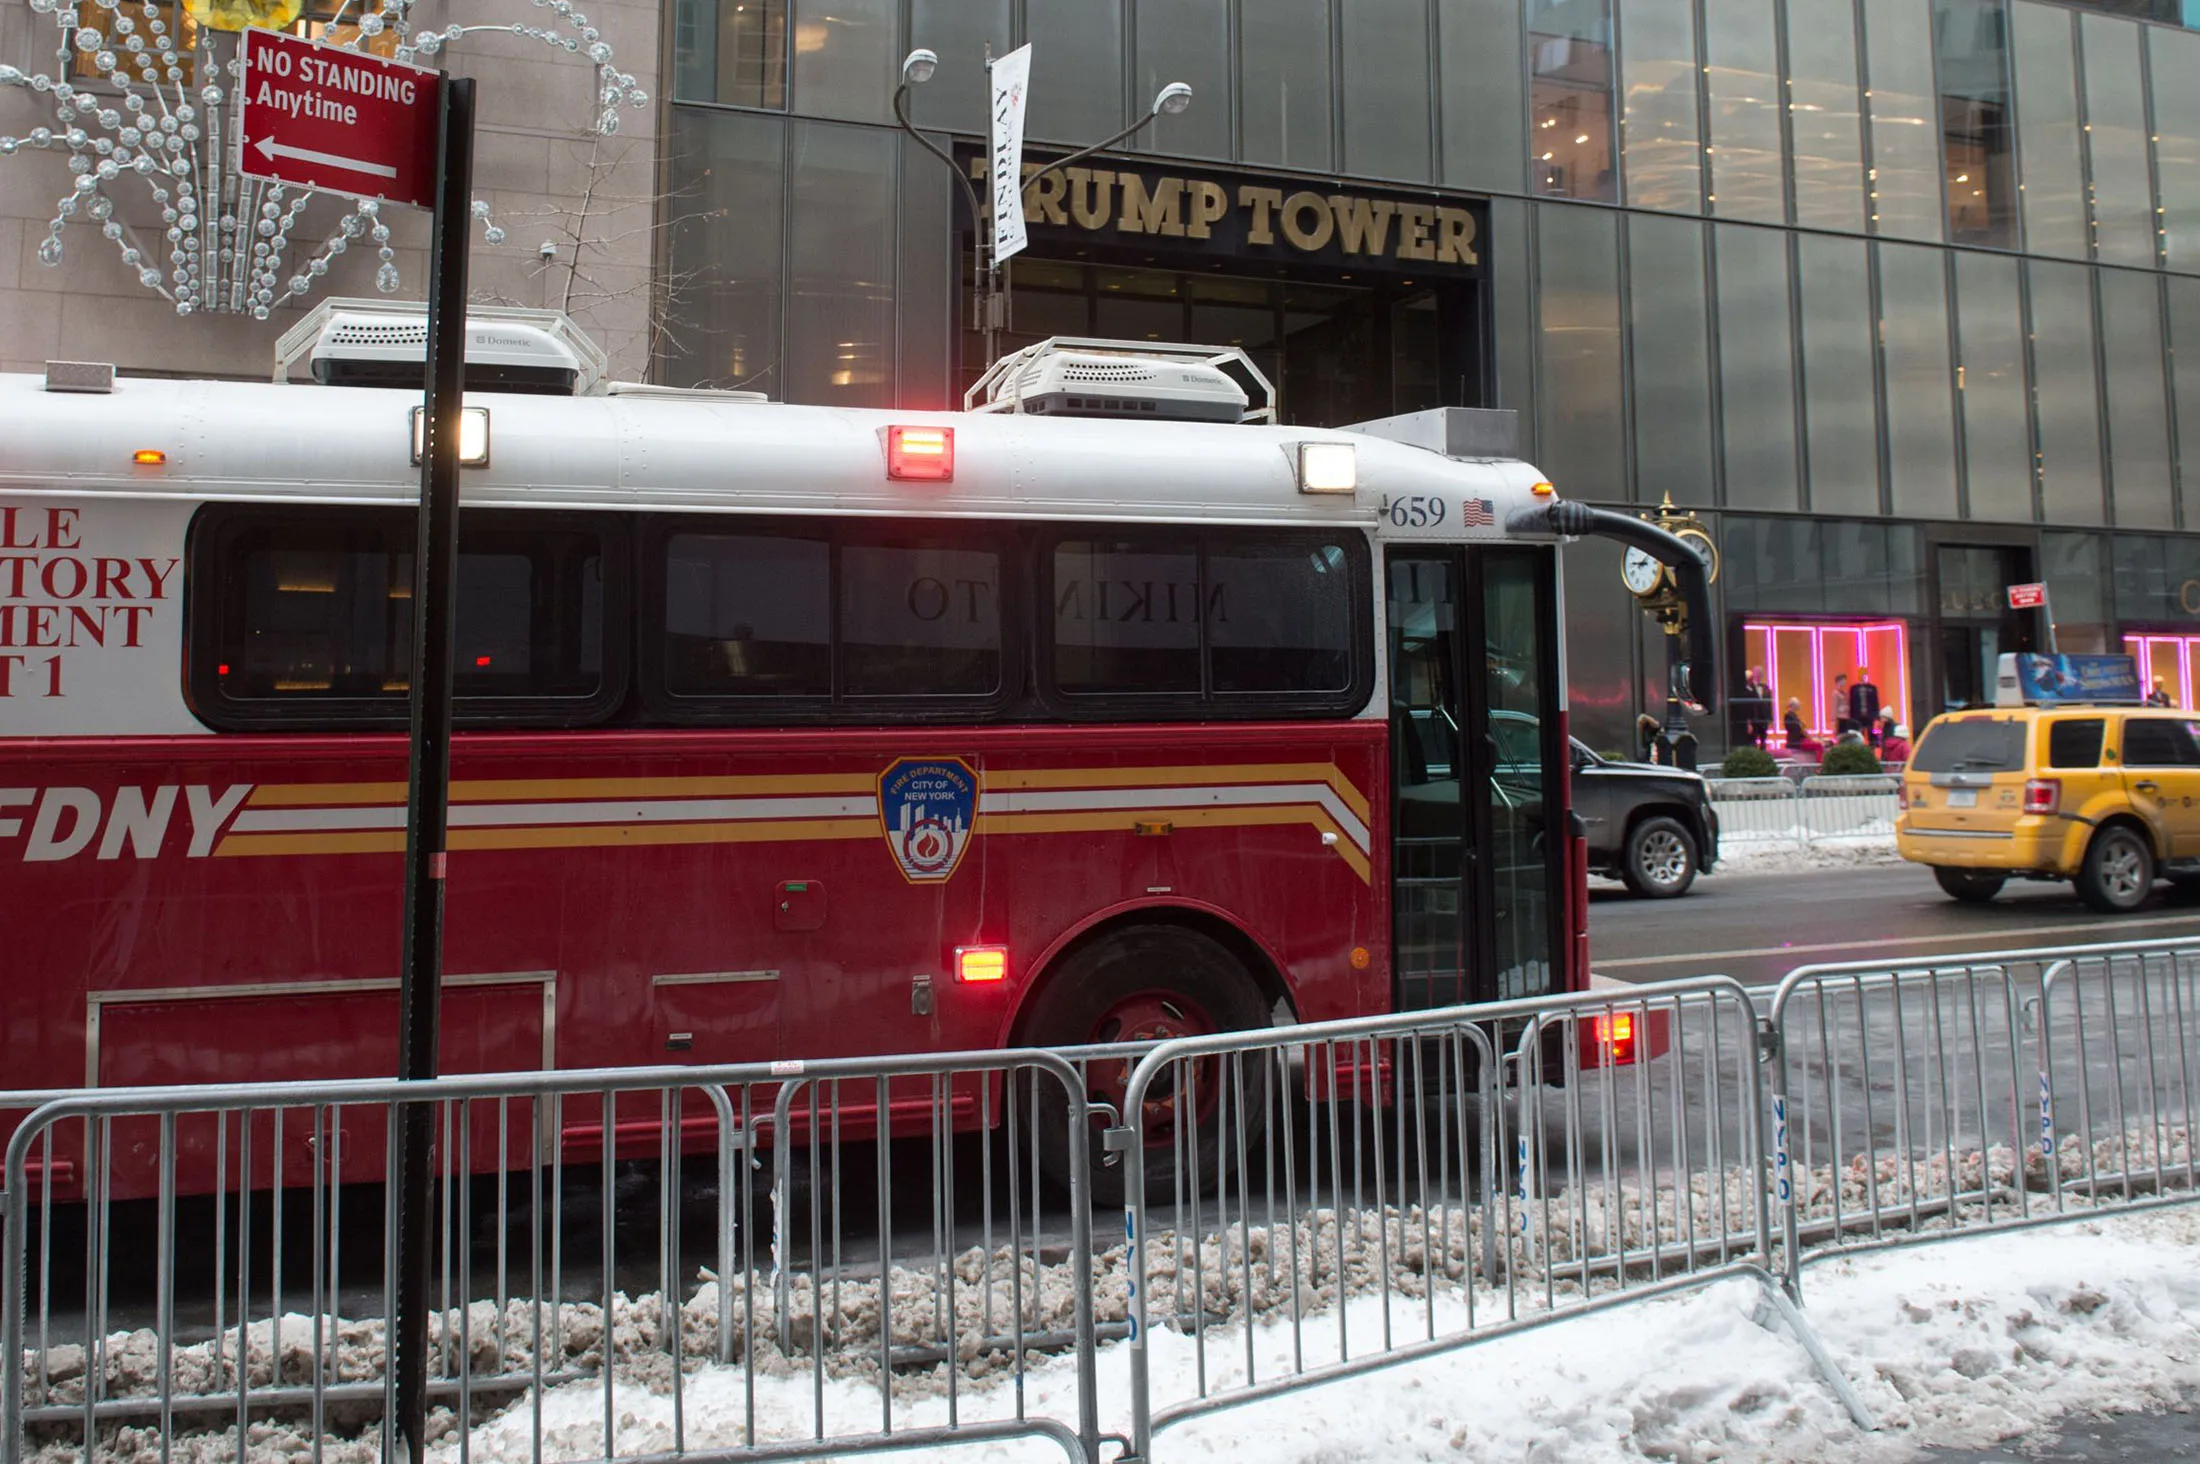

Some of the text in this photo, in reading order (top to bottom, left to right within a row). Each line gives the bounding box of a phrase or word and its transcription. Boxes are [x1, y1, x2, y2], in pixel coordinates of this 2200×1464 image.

[257, 46, 416, 105] NO STANDING
[256, 80, 358, 125] Anytime
[1238, 184, 1479, 265] TOWER
[487, 336, 531, 347] Dometic
[0, 506, 82, 549] LE
[1390, 496, 1446, 528] 659
[0, 556, 181, 600] TORY
[42, 654, 67, 698] 1
[890, 766, 969, 796] FIRE DEPARTMENT
[904, 791, 956, 801] NEW YORK
[911, 780, 949, 790] CITY OF
[0, 783, 254, 862] FDNY
[2041, 1077, 2053, 1155] NYPD
[1774, 1099, 1790, 1201] NYPD
